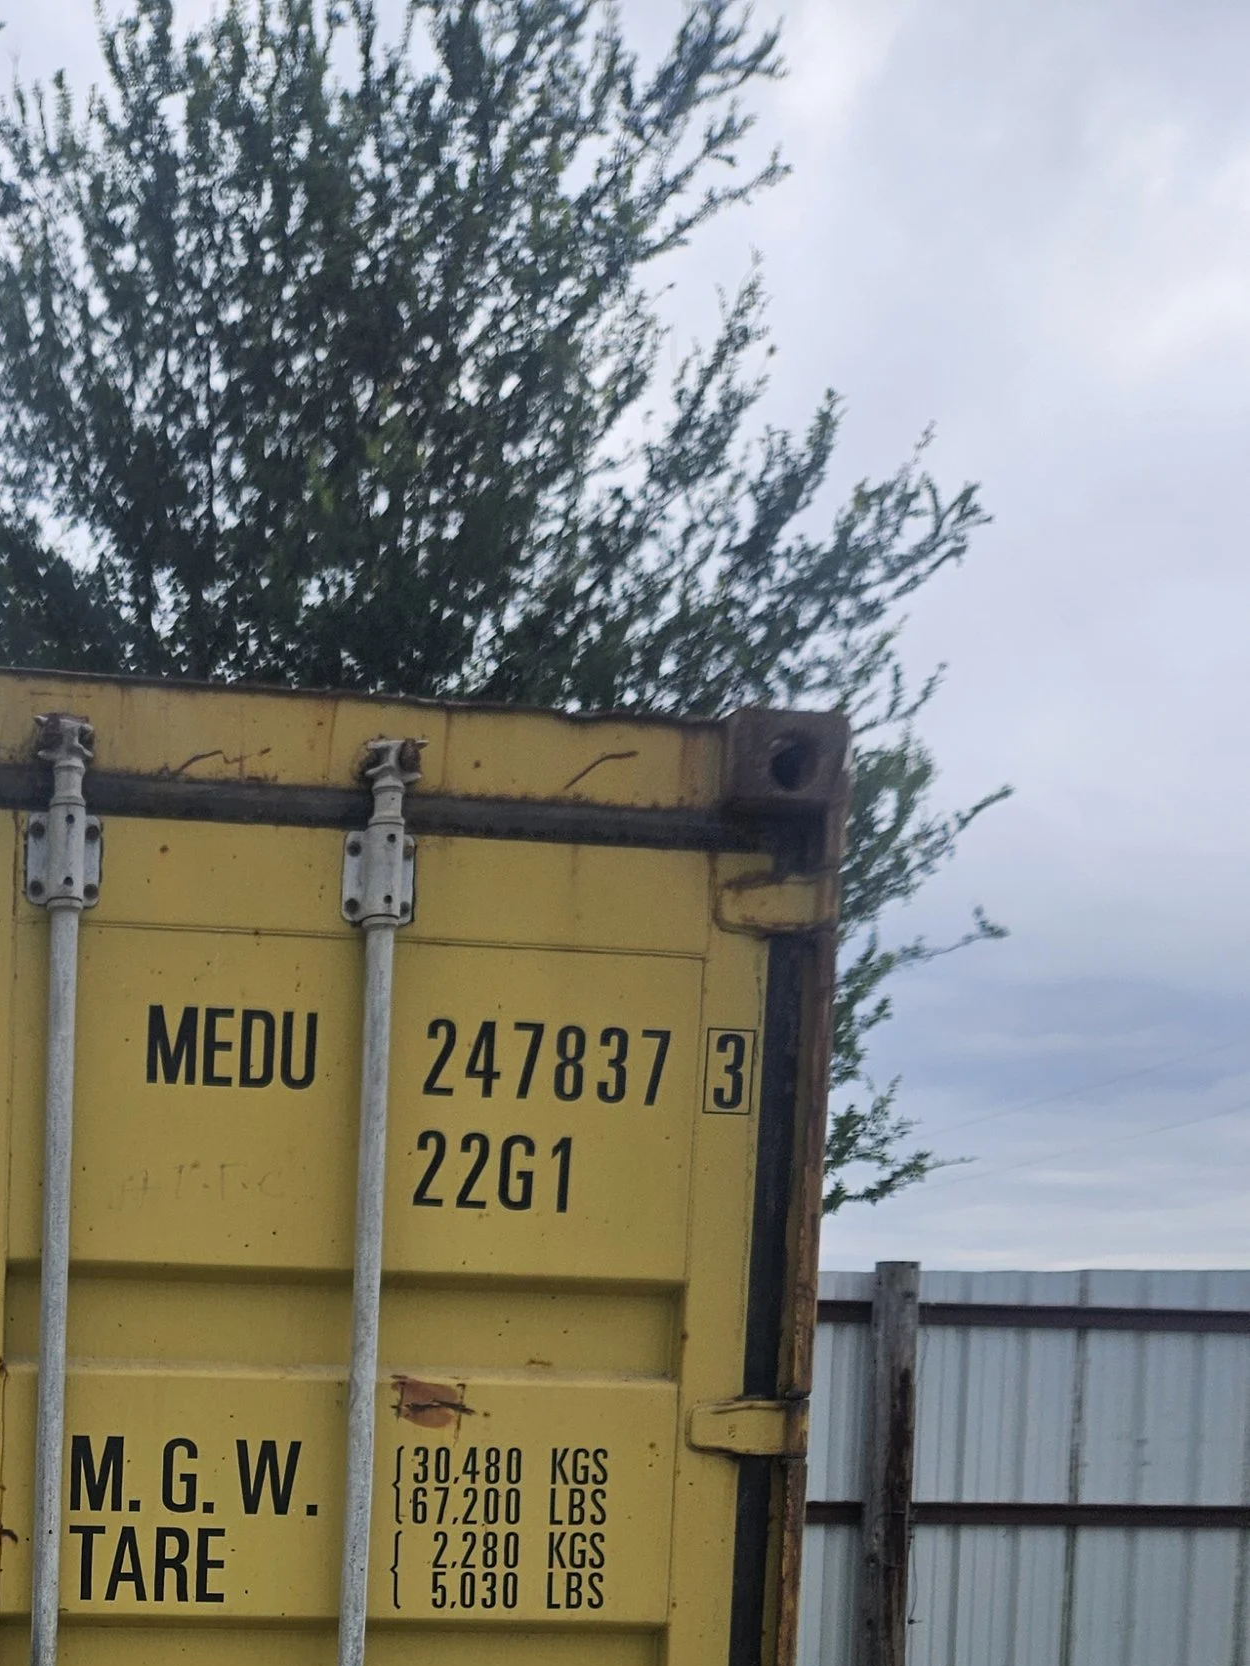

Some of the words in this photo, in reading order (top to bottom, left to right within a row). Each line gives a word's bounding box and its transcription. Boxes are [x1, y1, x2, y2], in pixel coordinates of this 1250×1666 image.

[147, 1005, 318, 1089] MEDU
[423, 1019, 671, 1105] 247837
[714, 1034, 745, 1109] 3
[413, 1130, 572, 1212] 22G1
[413, 1447, 521, 1484] 30,480
[551, 1448, 608, 1485] KGS
[413, 1487, 520, 1524] 67,200
[550, 1488, 606, 1525] LBS
[69, 1525, 225, 1602] TARE
[433, 1531, 519, 1568] 2,280
[548, 1532, 604, 1569] KGS
[432, 1572, 518, 1608] 5,030
[547, 1572, 603, 1609] LBS
